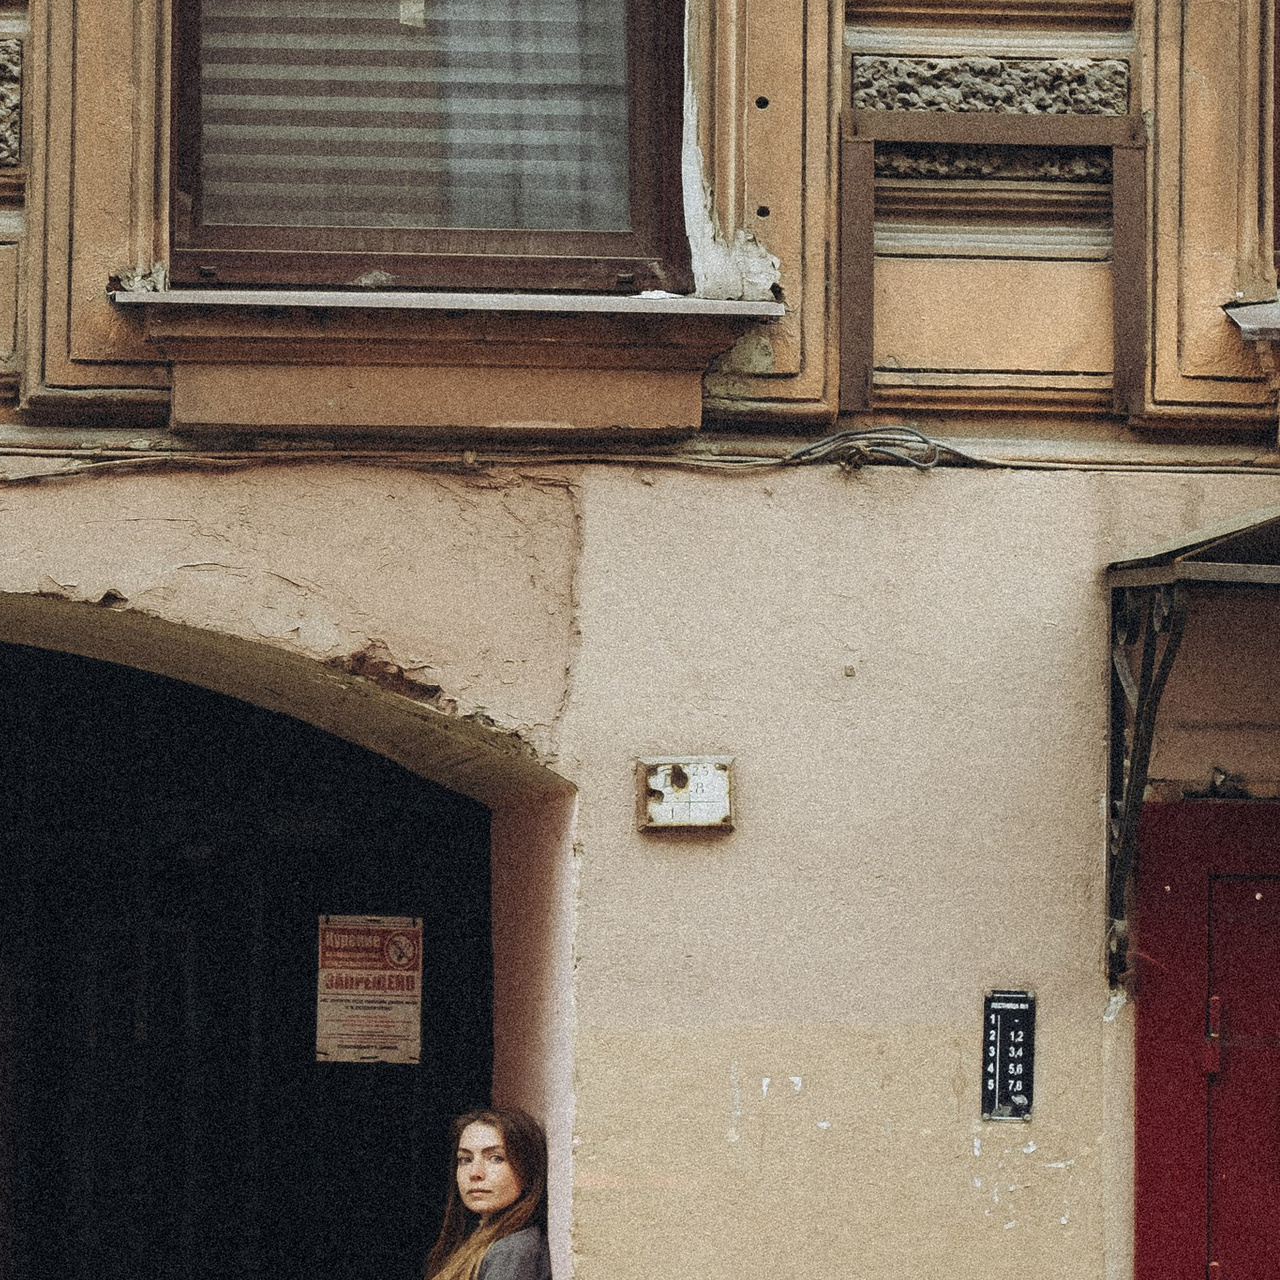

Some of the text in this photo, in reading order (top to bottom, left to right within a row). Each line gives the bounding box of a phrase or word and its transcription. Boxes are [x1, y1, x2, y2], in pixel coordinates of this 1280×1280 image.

[990, 1013, 996, 1024] 1
[989, 1030, 1024, 1042] 2 1,2
[988, 1046, 1023, 1058] 3 3,4
[987, 1062, 1023, 1075] 4 5,6
[987, 1079, 1023, 1092] 5 7,8
